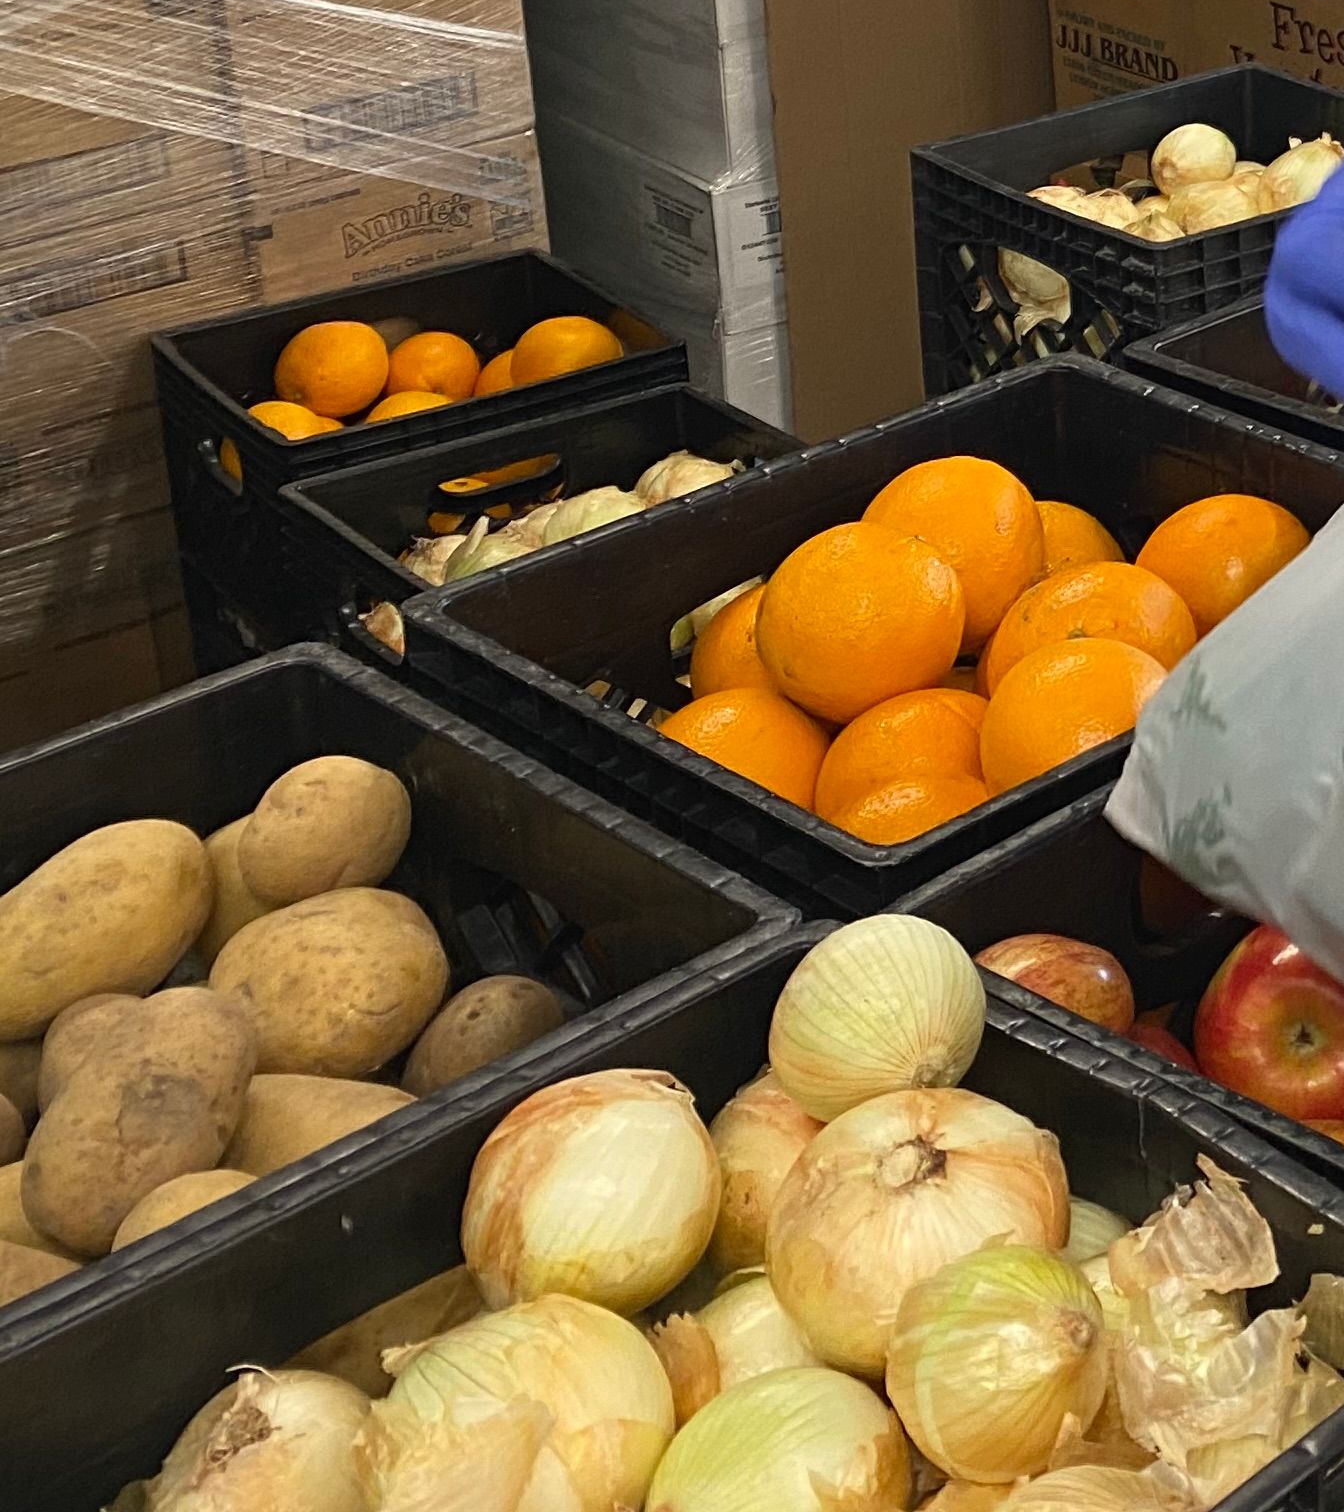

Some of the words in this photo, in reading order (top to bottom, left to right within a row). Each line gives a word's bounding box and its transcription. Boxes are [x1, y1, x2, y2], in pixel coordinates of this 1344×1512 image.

[1057, 24, 1092, 58] JJJ
[1101, 37, 1178, 82] BRAND
[342, 192, 471, 258] Annie's
